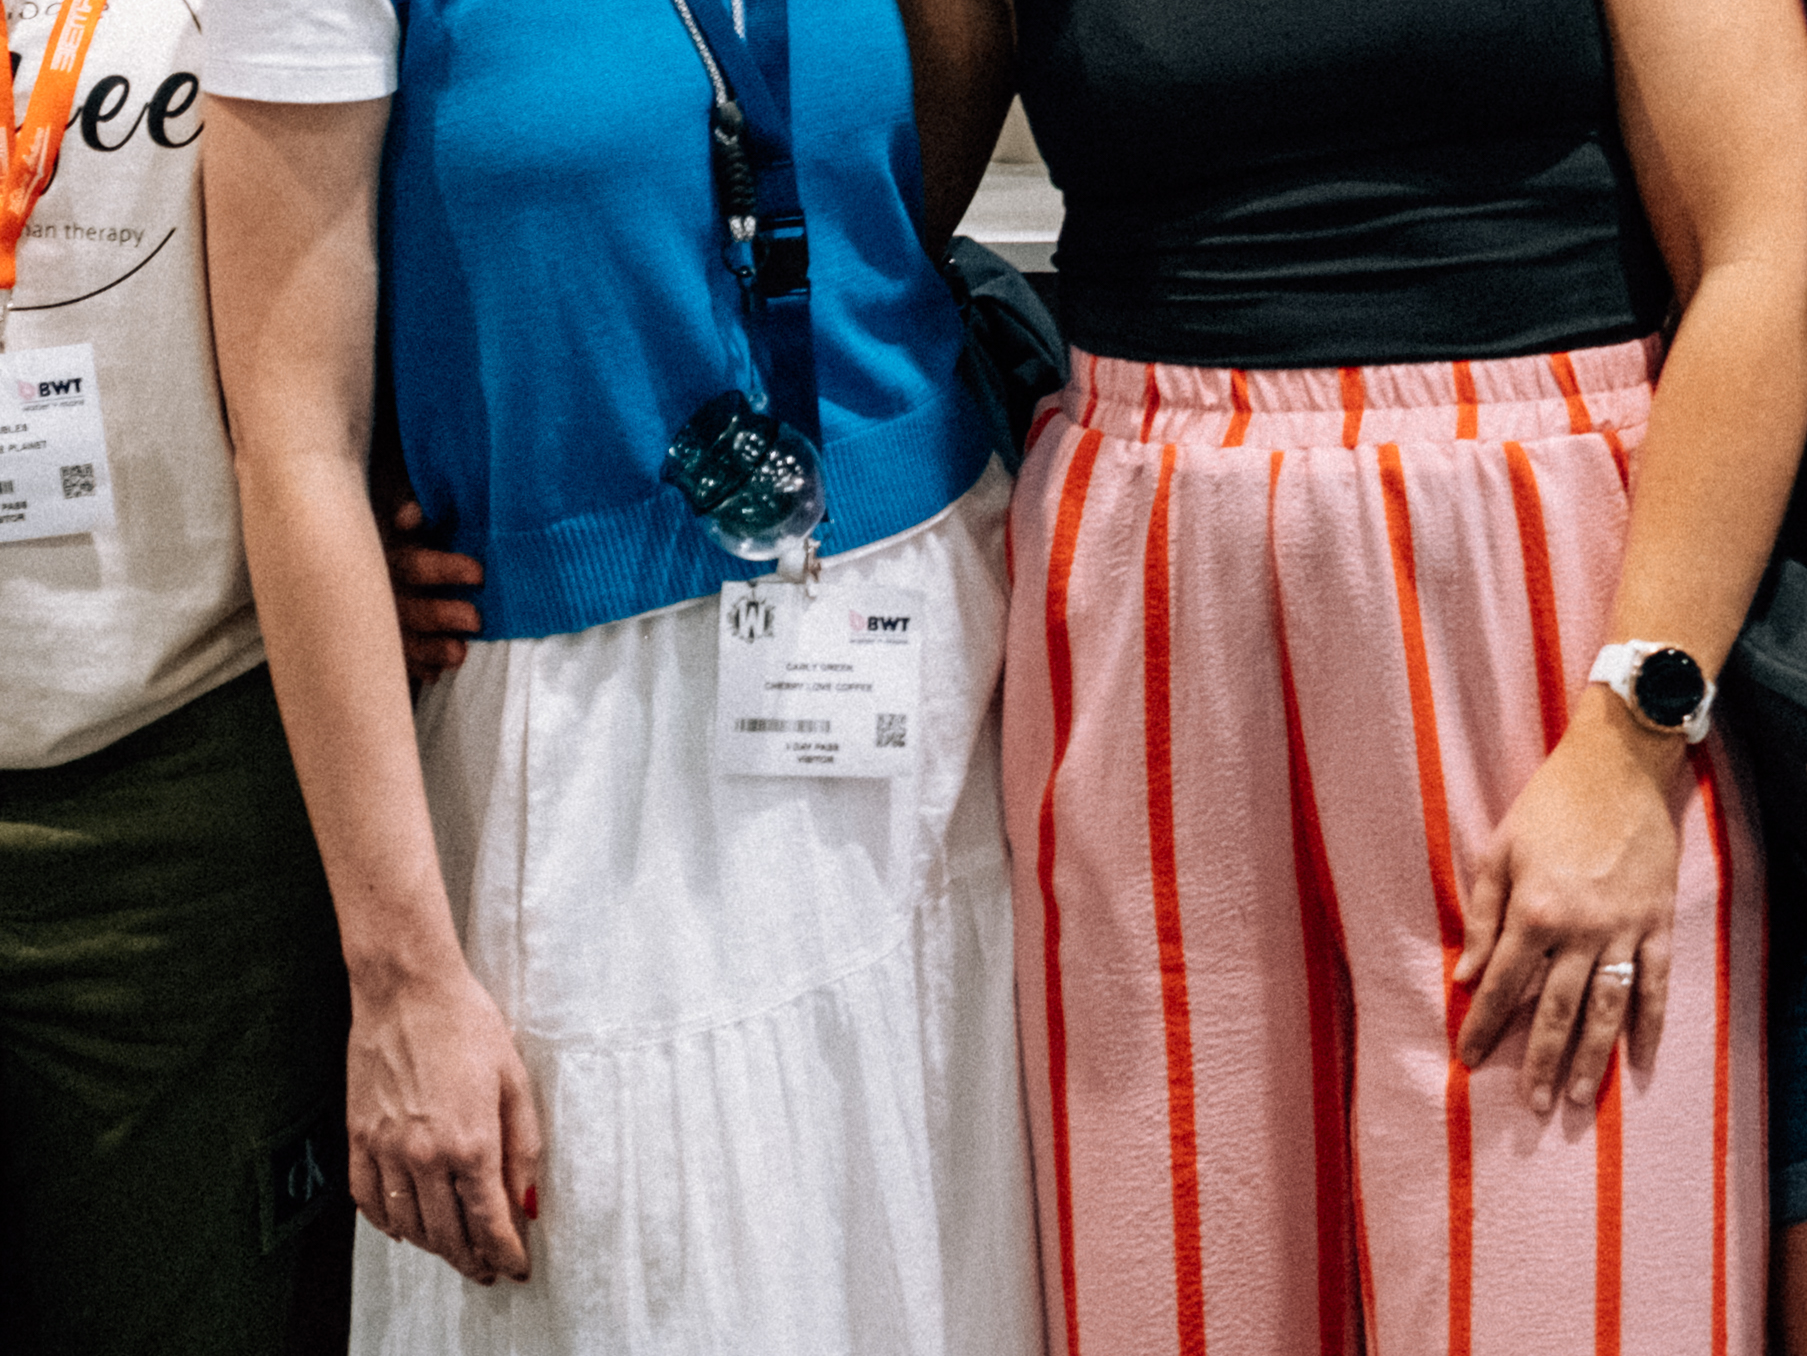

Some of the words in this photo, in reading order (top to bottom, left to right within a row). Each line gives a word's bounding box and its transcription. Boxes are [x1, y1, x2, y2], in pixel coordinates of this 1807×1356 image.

[64, 223, 145, 248] therapy
[38, 377, 84, 399] BWT
[867, 615, 911, 632] BWT
